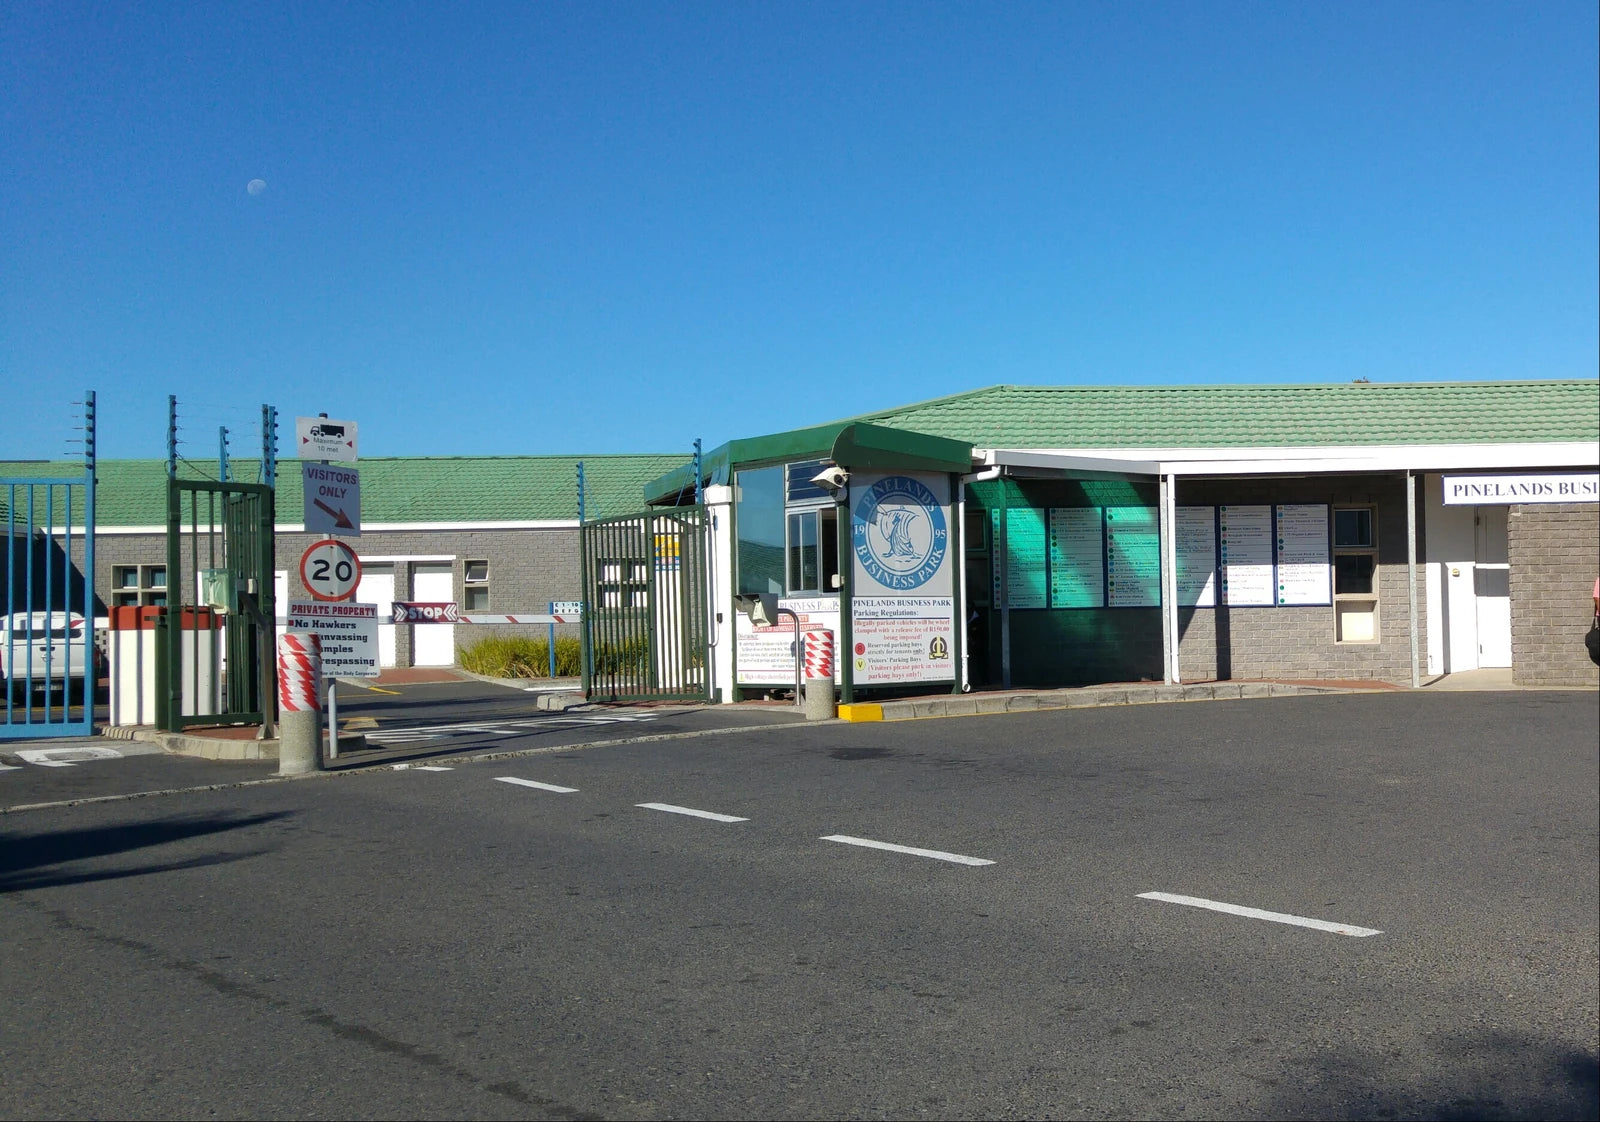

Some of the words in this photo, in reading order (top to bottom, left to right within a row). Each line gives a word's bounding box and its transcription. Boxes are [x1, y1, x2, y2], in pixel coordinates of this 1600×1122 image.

[308, 467, 358, 485] VISITORS
[318, 486, 347, 499] ONLY
[864, 478, 937, 512] PINELANDS
[1454, 482, 1553, 497] PINELANDS
[1559, 482, 1597, 495] BUSI
[854, 525, 865, 534] 19
[935, 529, 946, 539] 95
[312, 559, 352, 582] 20
[857, 545, 915, 588] BUSINESS
[918, 547, 943, 582] PARK
[292, 604, 329, 614] PRIVATE
[332, 607, 376, 616] PROPERTY
[408, 607, 442, 619] STOP
[295, 620, 308, 628] No
[312, 620, 356, 629] Hawkers
[321, 658, 375, 666] respassing
